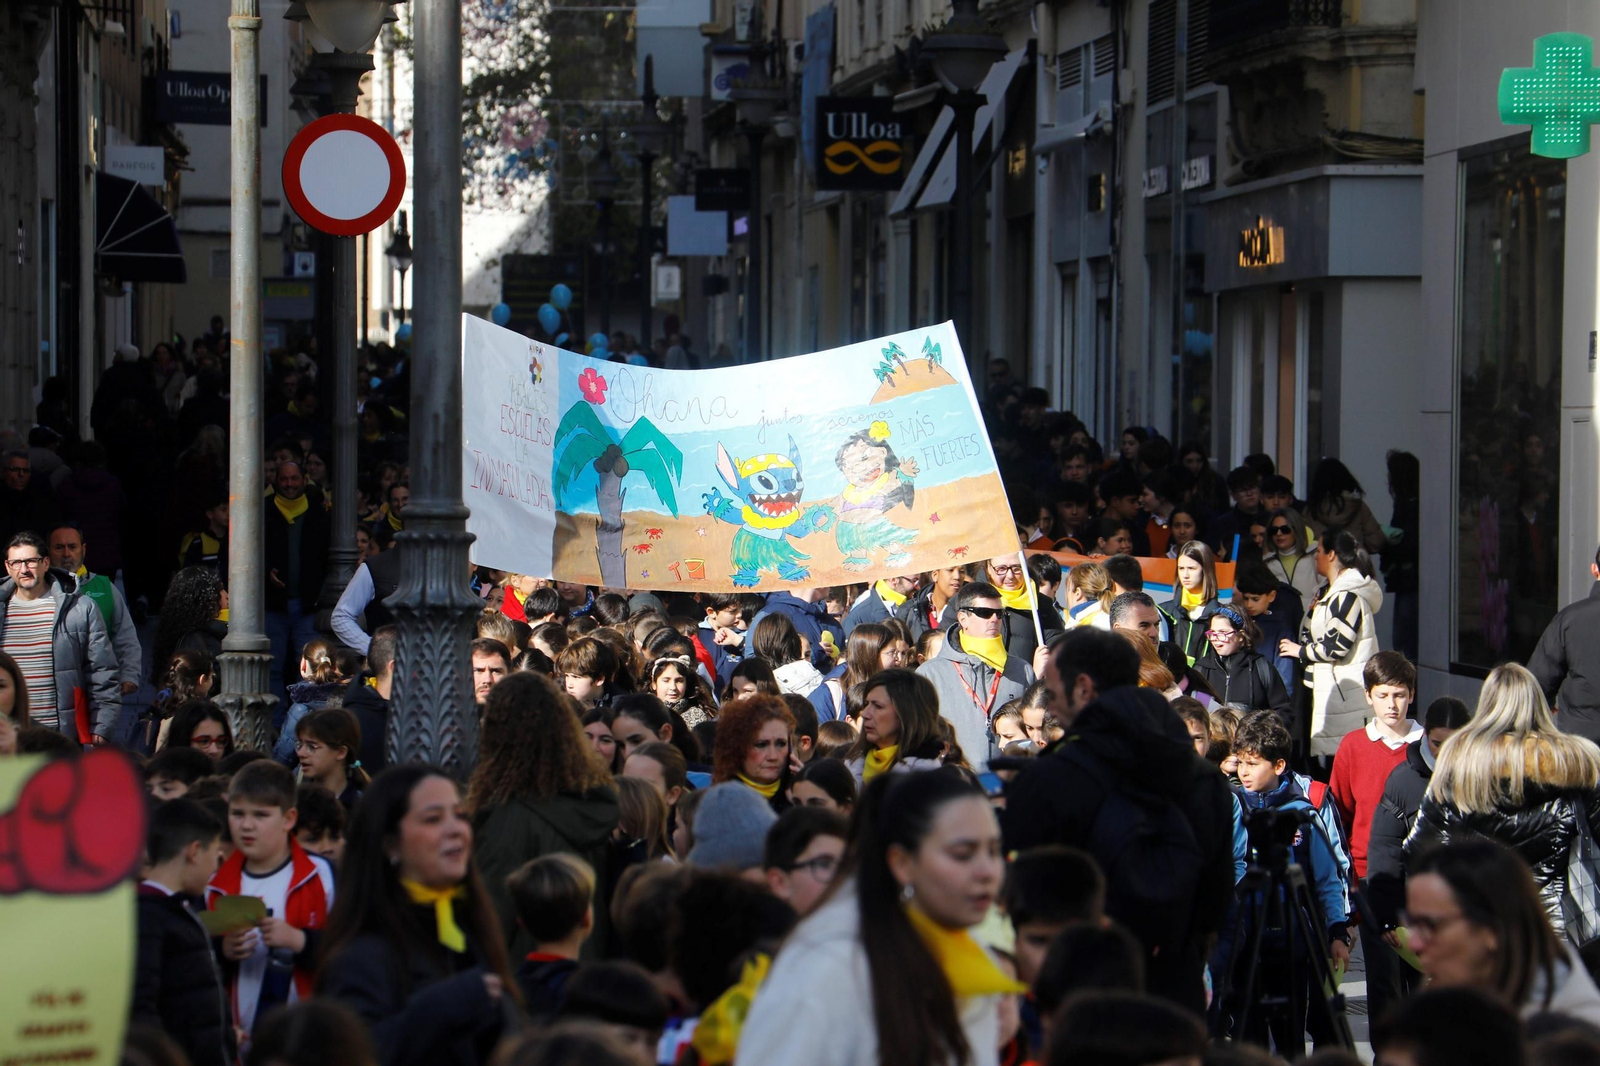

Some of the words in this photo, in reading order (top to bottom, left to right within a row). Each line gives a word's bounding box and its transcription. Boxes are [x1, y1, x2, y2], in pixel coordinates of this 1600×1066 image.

[825, 112, 901, 139] Ulloa
[609, 367, 739, 425] Ohana
[500, 403, 552, 447] ESCUELAS
[757, 407, 804, 445] juntos
[826, 408, 894, 430] seremos
[896, 410, 935, 446] MÁS
[514, 443, 530, 464] LA
[920, 433, 981, 471] FUERTES
[470, 449, 551, 511] INMACULADA
